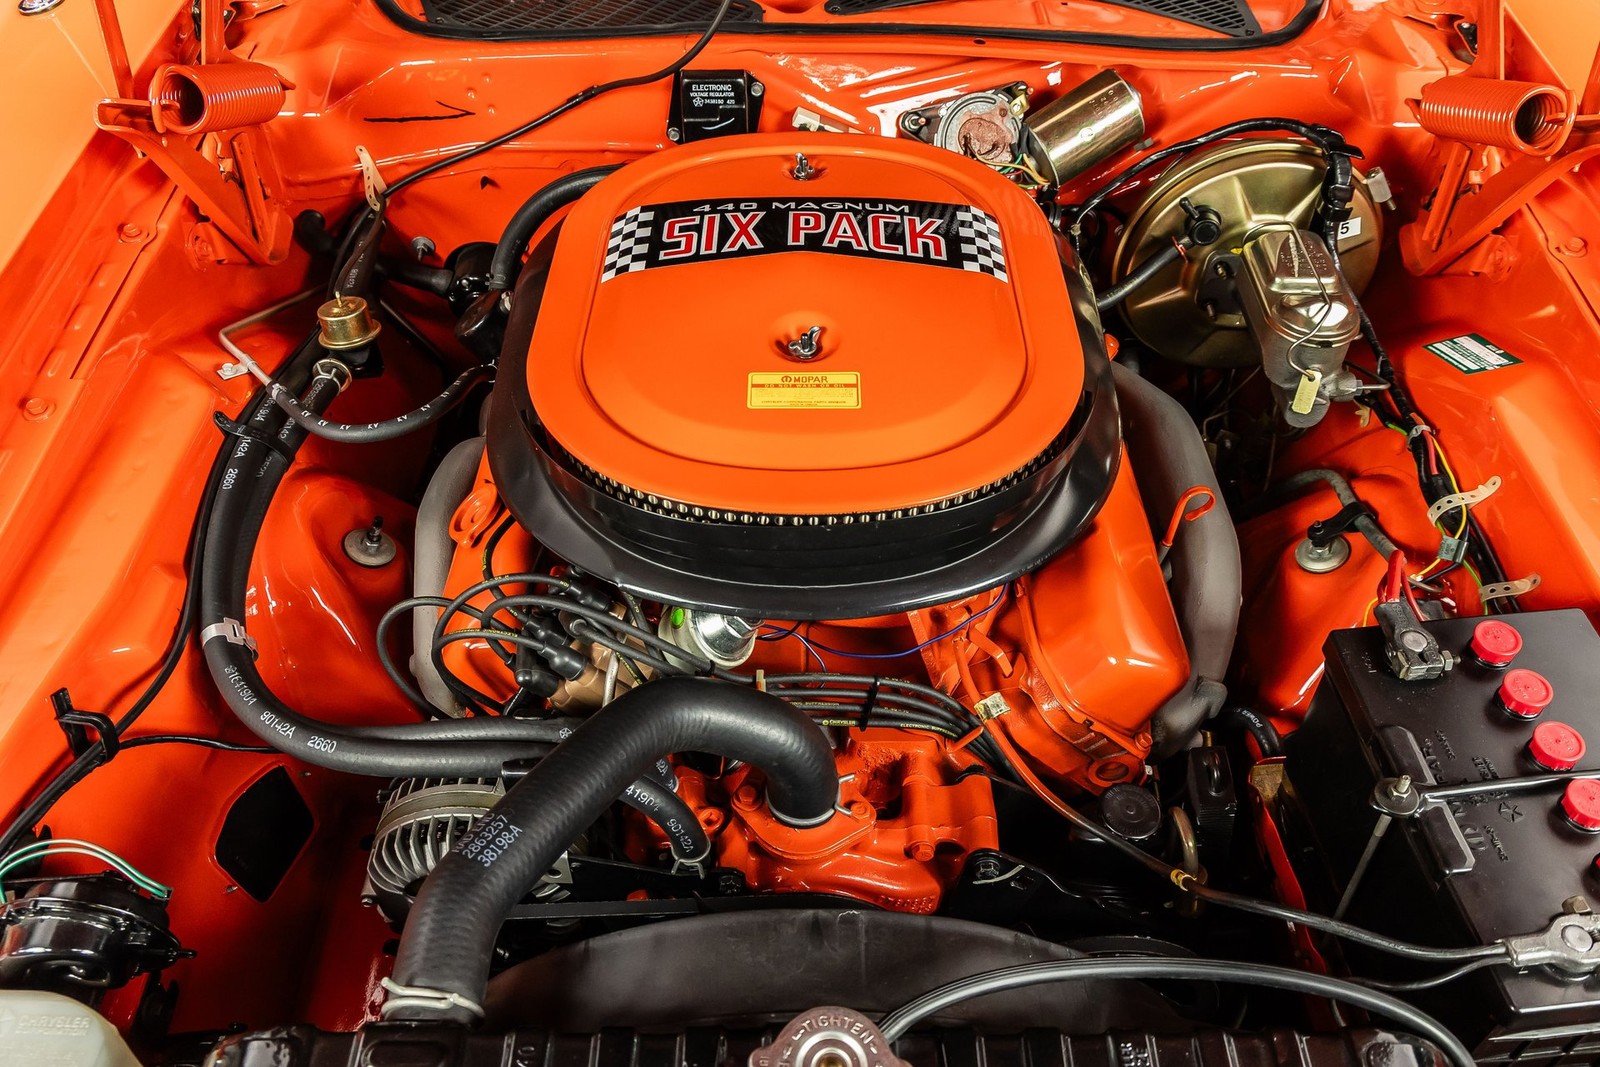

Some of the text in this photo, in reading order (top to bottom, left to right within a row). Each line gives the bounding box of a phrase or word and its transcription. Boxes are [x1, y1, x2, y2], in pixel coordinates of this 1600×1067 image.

[693, 202, 909, 213] 440 MAGNUM
[658, 211, 947, 261] SIX PACK
[222, 468, 239, 490] 2660
[260, 711, 296, 739] 90142A
[307, 735, 337, 753] 2660
[462, 814, 508, 859] 2863257
[477, 825, 523, 868] 38198-A
[18, 1015, 90, 1029] CHRYSLER
